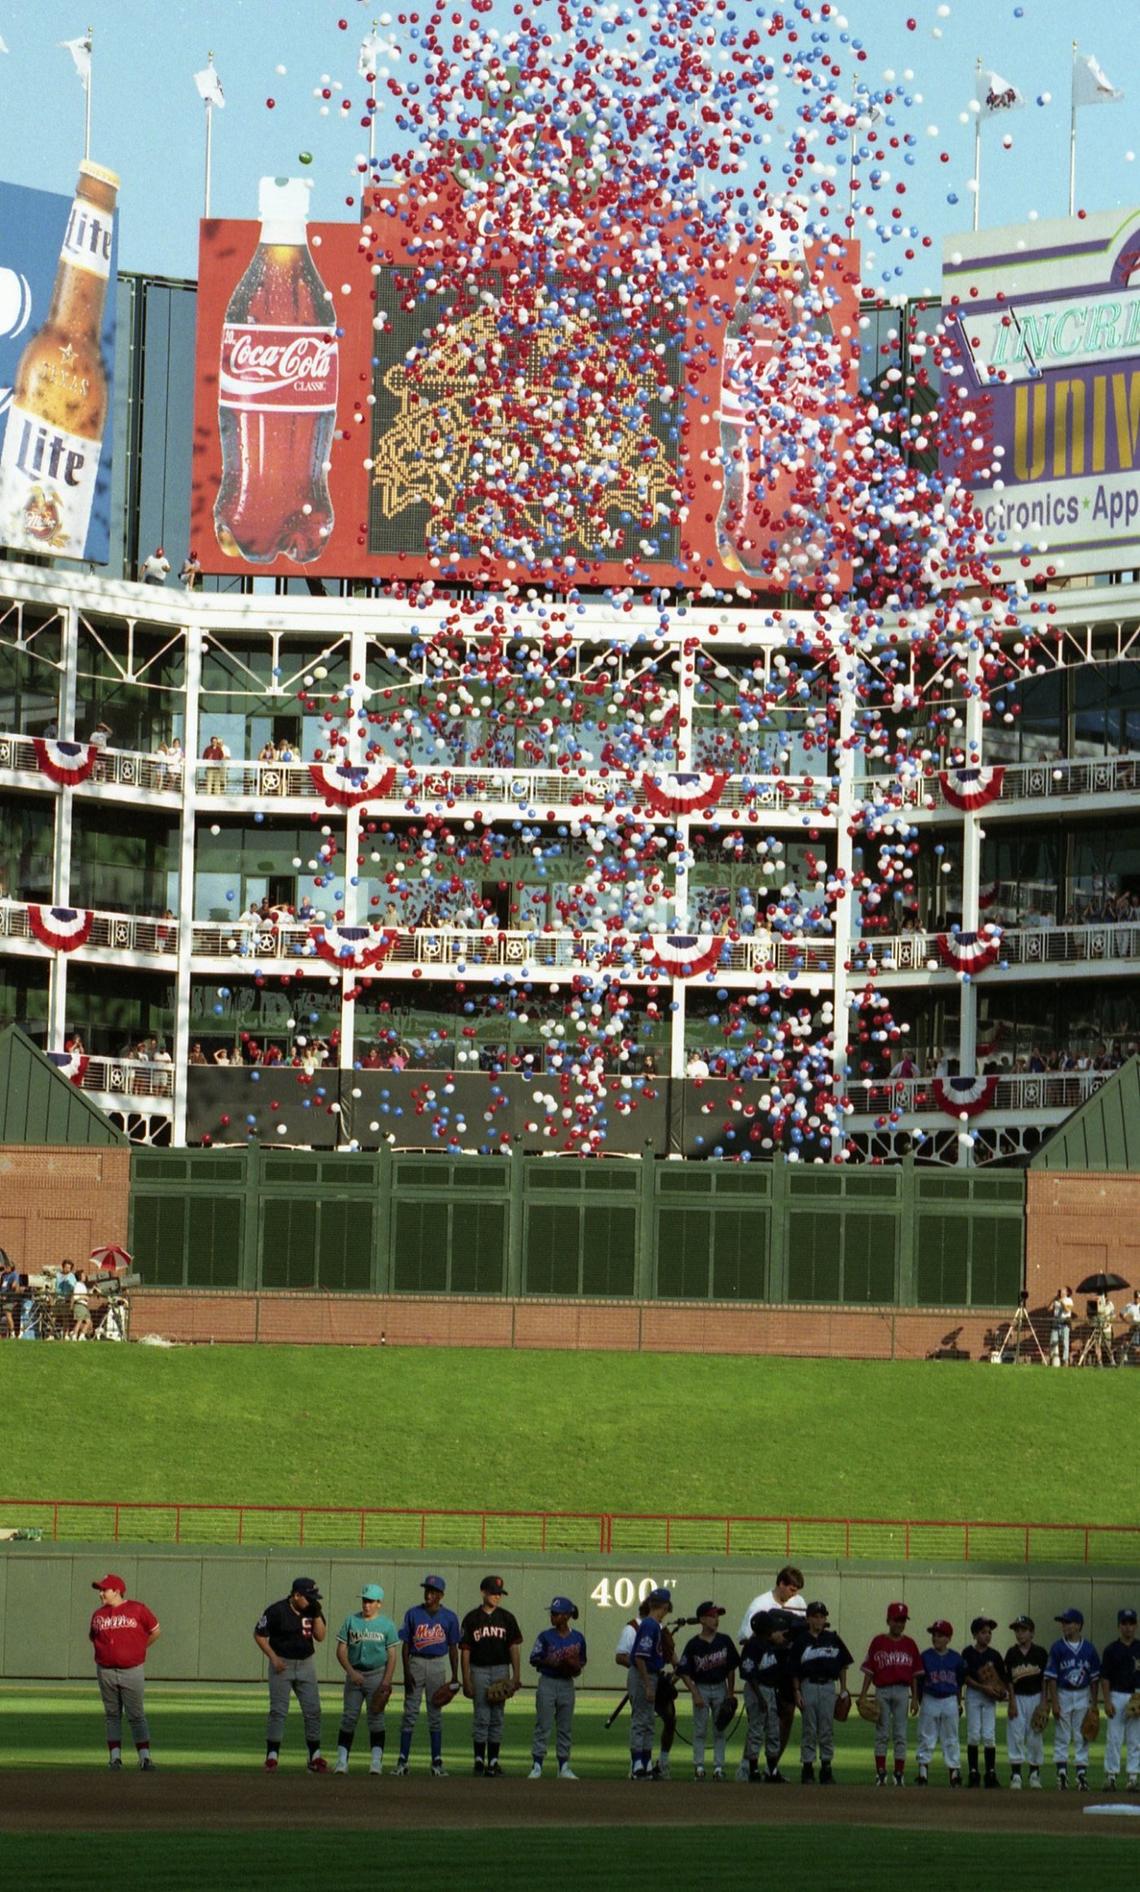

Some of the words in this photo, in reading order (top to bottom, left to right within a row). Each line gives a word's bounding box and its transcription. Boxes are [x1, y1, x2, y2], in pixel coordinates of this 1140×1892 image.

[65, 208, 112, 261] Lite
[230, 335, 338, 378] Coca-Cola
[293, 381, 326, 392] CLASSIC
[16, 420, 85, 487] Lite
[985, 493, 1079, 533] ctronics
[590, 1577, 658, 1608] 400
[473, 1626, 507, 1642] GIANT
